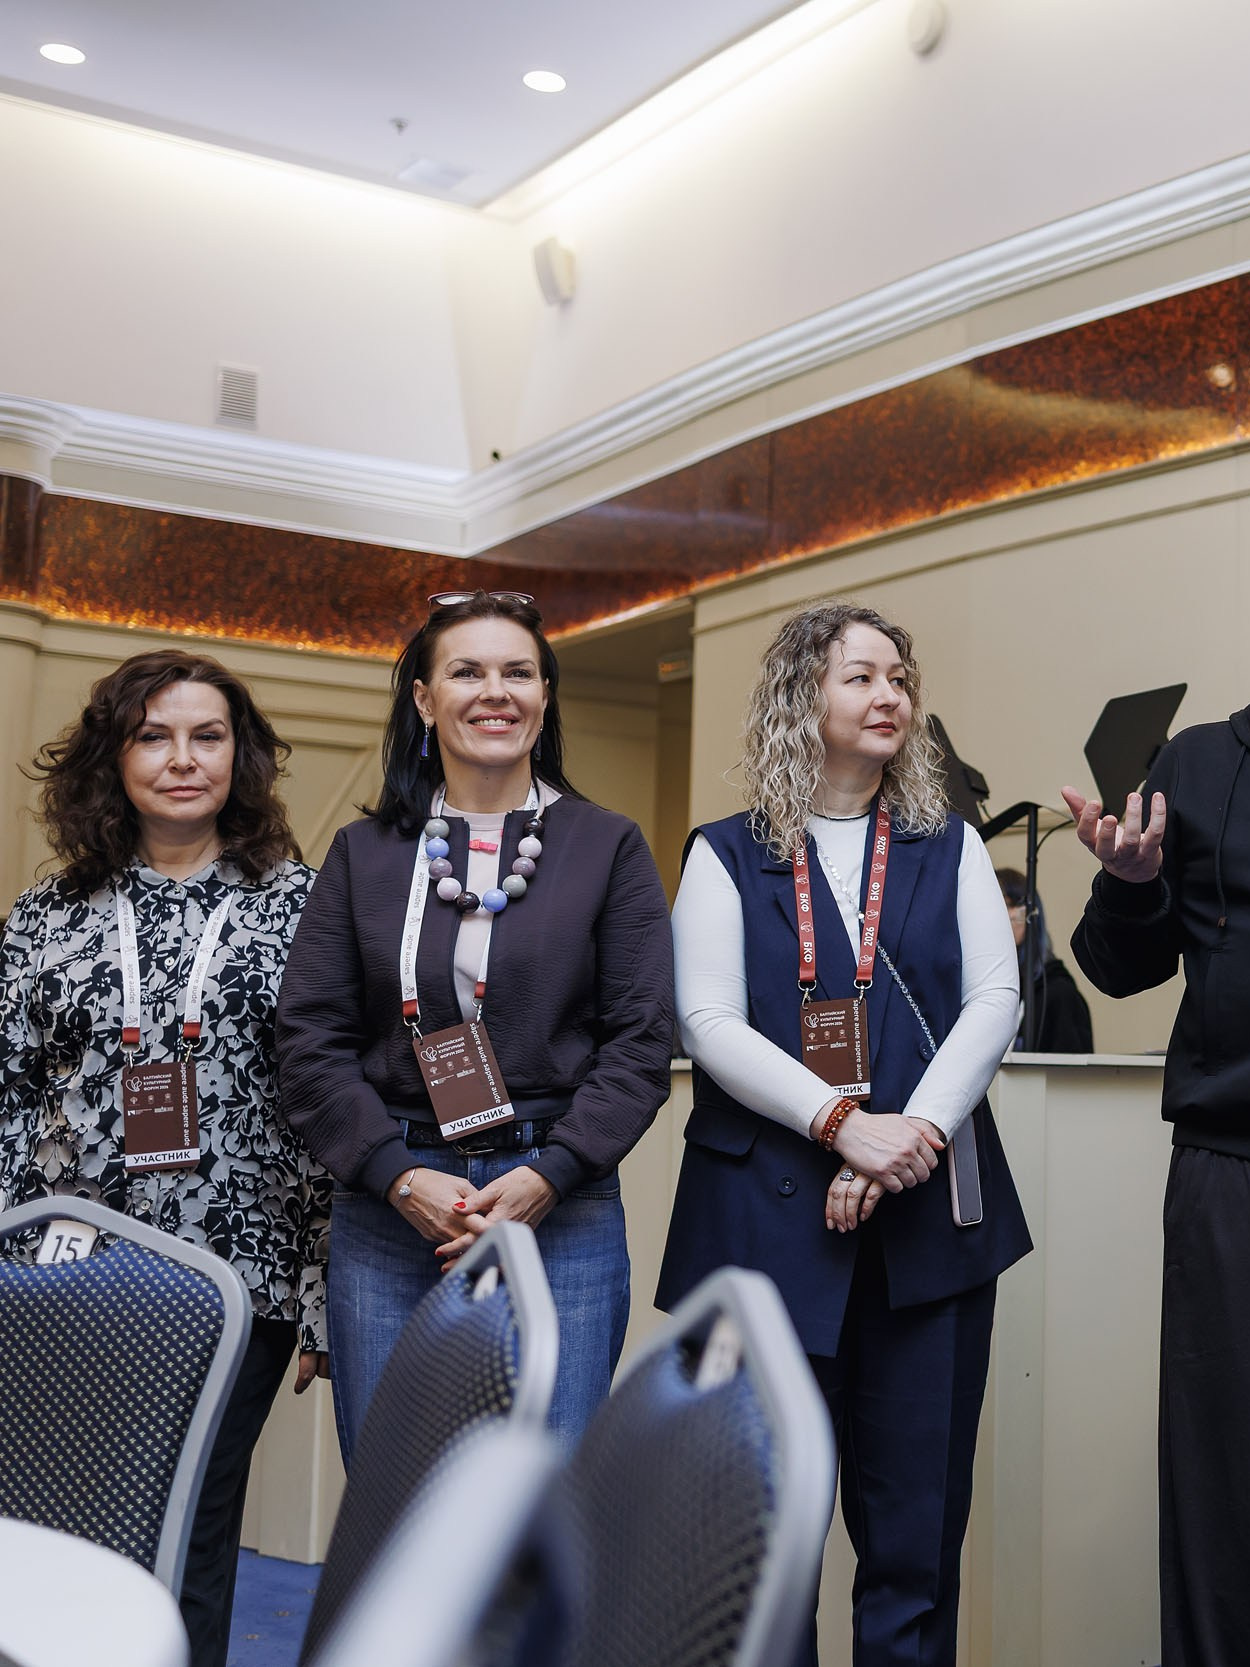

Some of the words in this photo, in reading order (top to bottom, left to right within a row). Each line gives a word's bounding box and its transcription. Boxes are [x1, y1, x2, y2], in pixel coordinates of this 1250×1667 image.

[876, 835, 887, 856] 2026
[870, 882, 880, 901] БКФ
[799, 892, 809, 913] БКФ
[864, 926, 875, 947] 2026
[803, 941, 813, 963] БКФ
[469, 1022, 481, 1045] sapere
[477, 1046, 488, 1063] aude
[483, 1063, 495, 1086] sapere
[491, 1087, 501, 1104] aude
[181, 1086, 189, 1104] aude
[834, 1085, 864, 1095] ТНИК
[181, 1105, 189, 1128] sapere
[449, 1107, 506, 1131] УЧАСТНИК
[133, 1151, 191, 1164] УЧАСТНИК
[51, 1233, 83, 1262] 15
